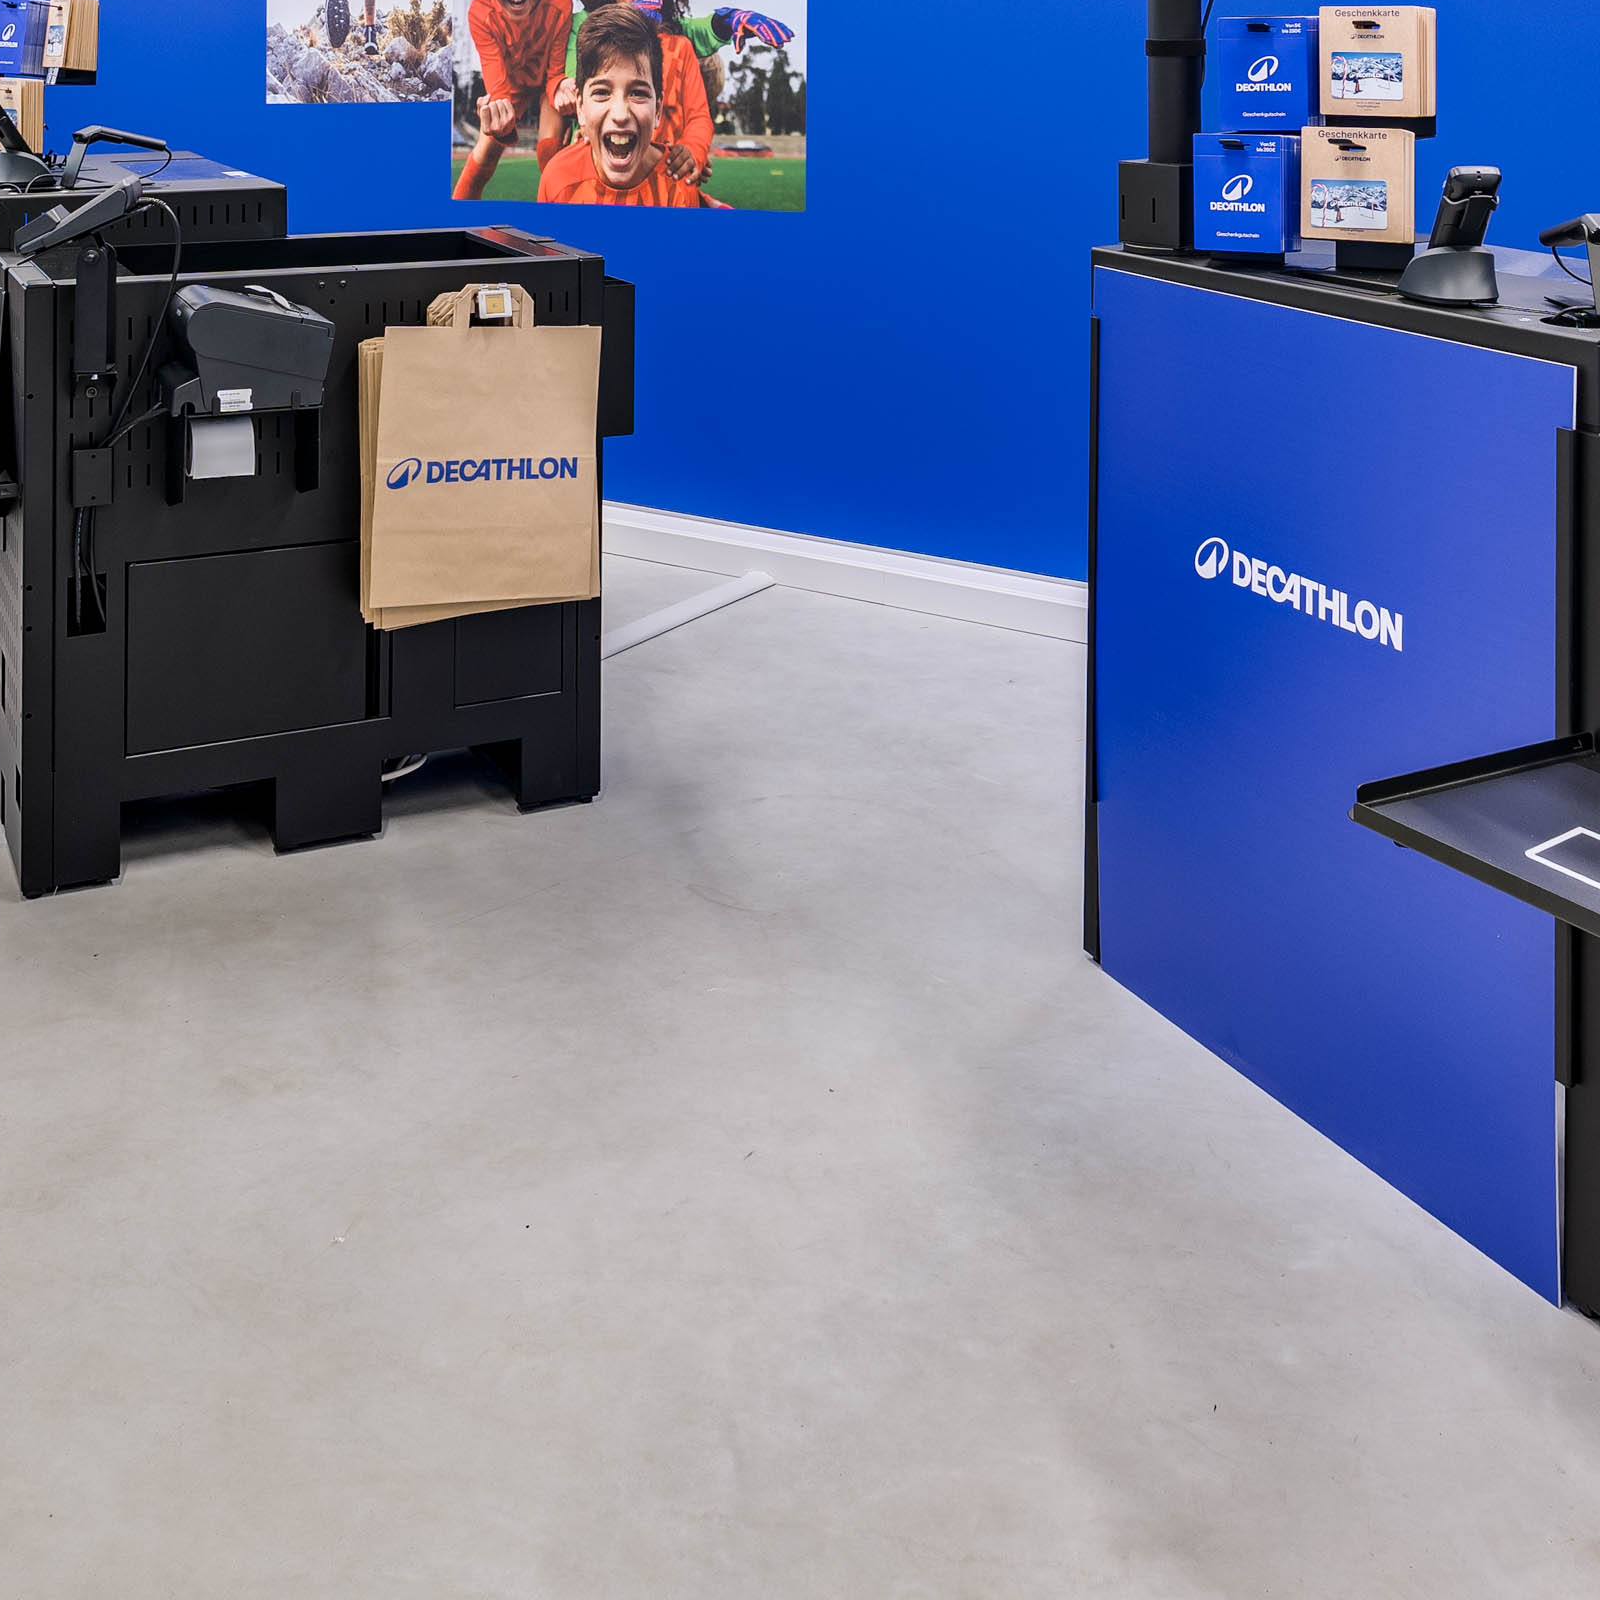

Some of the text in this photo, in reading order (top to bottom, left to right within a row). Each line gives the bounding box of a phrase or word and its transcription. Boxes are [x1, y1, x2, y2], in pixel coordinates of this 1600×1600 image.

[1334, 9, 1400, 17] Geschenkkarte
[1236, 82, 1292, 92] DECATHLON
[1317, 129, 1388, 140] Geschenkkarte
[1209, 201, 1266, 213] DECATHLON
[426, 456, 579, 484] DECATHLON
[1232, 549, 1404, 653] DECATHLON
